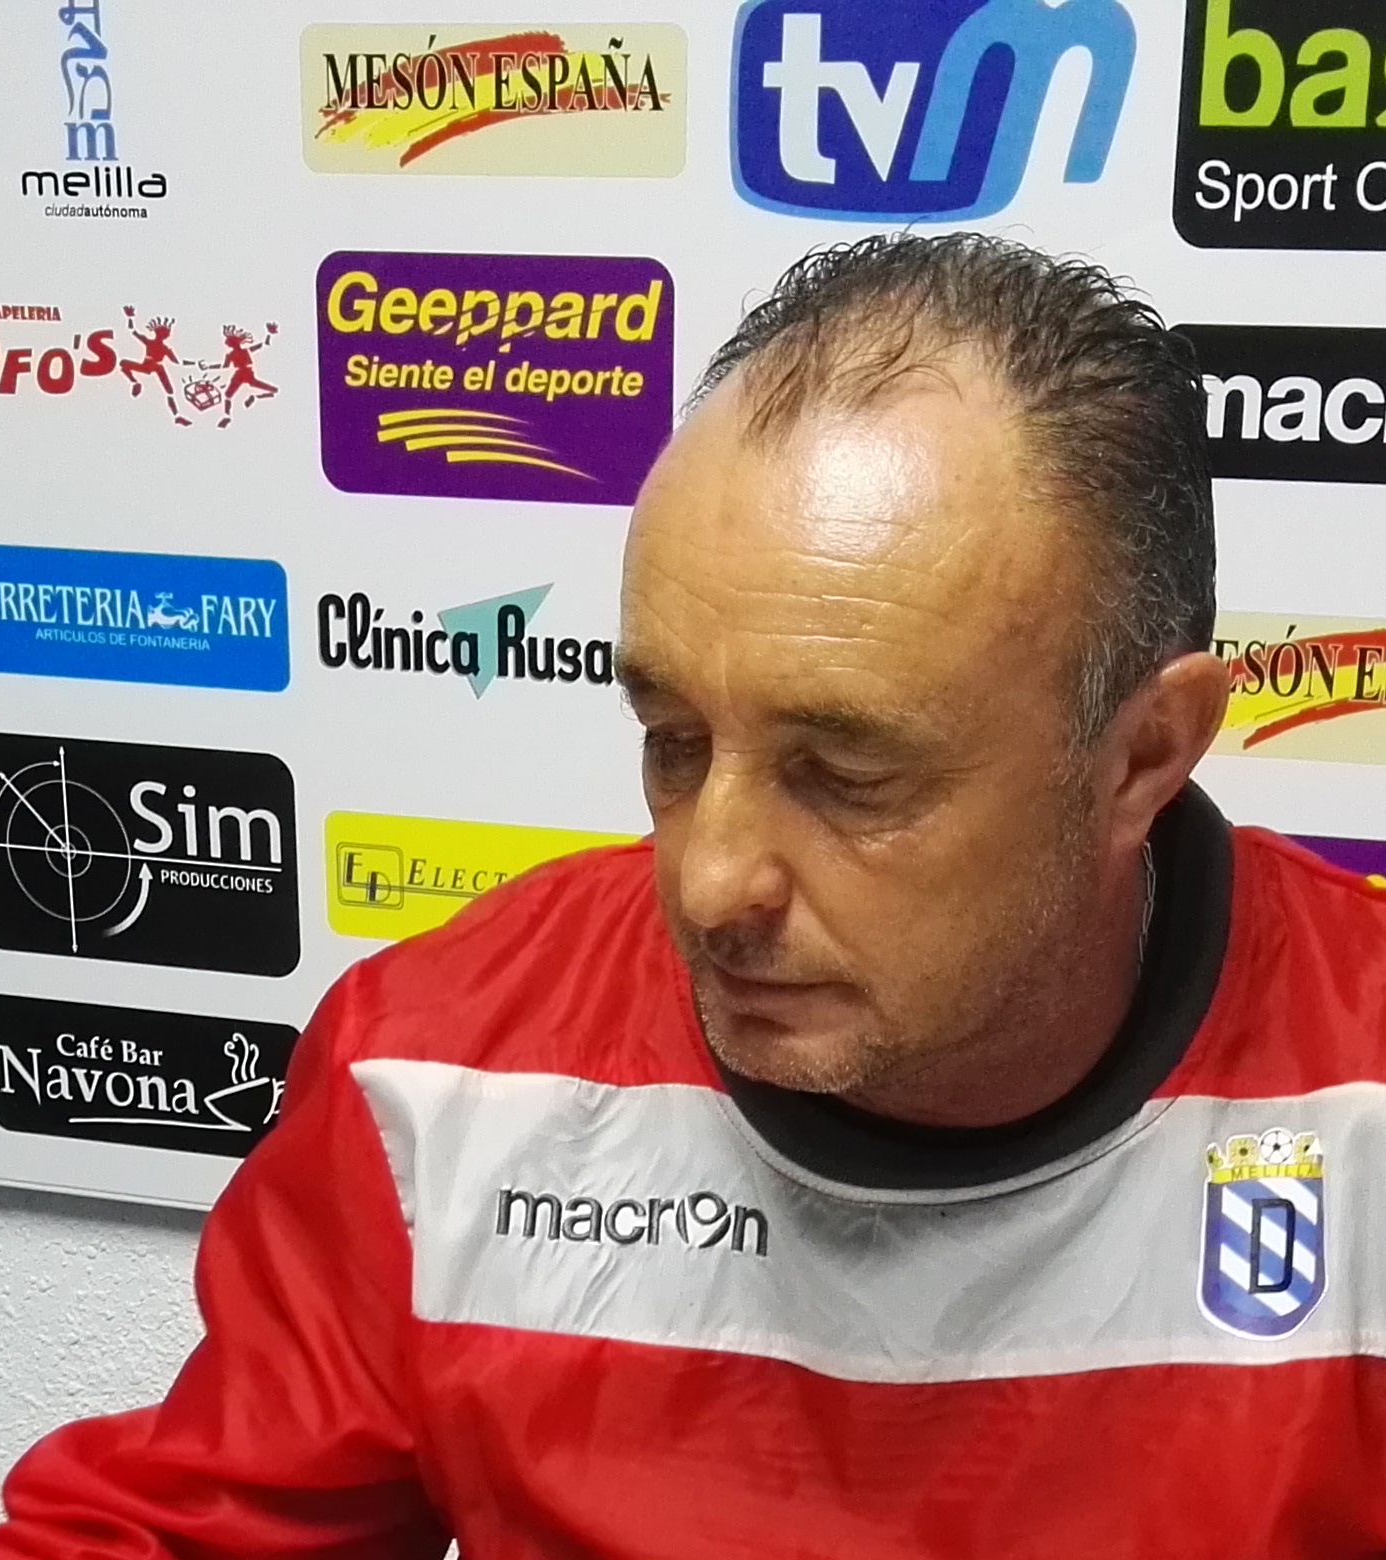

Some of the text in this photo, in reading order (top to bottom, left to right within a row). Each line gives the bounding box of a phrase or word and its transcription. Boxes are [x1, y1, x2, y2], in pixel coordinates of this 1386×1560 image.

[322, 35, 665, 113] MESÓN ESPAÑA
[21, 165, 168, 199] melilla
[1194, 160, 1337, 222] Sport
[326, 271, 663, 353] Geeppard
[344, 354, 644, 401] Siente el deporte
[35, 627, 107, 645] ARTICULOS
[109, 632, 126, 646] DE
[201, 594, 278, 640] FARY
[317, 592, 615, 686] Clínica Rusa
[1213, 623, 1340, 703] ESÓN
[127, 779, 283, 866] Sim
[160, 869, 274, 895] PRODUCCIONES
[55, 1032, 163, 1068] Café Bar
[1249, 1198, 1295, 1296] D
